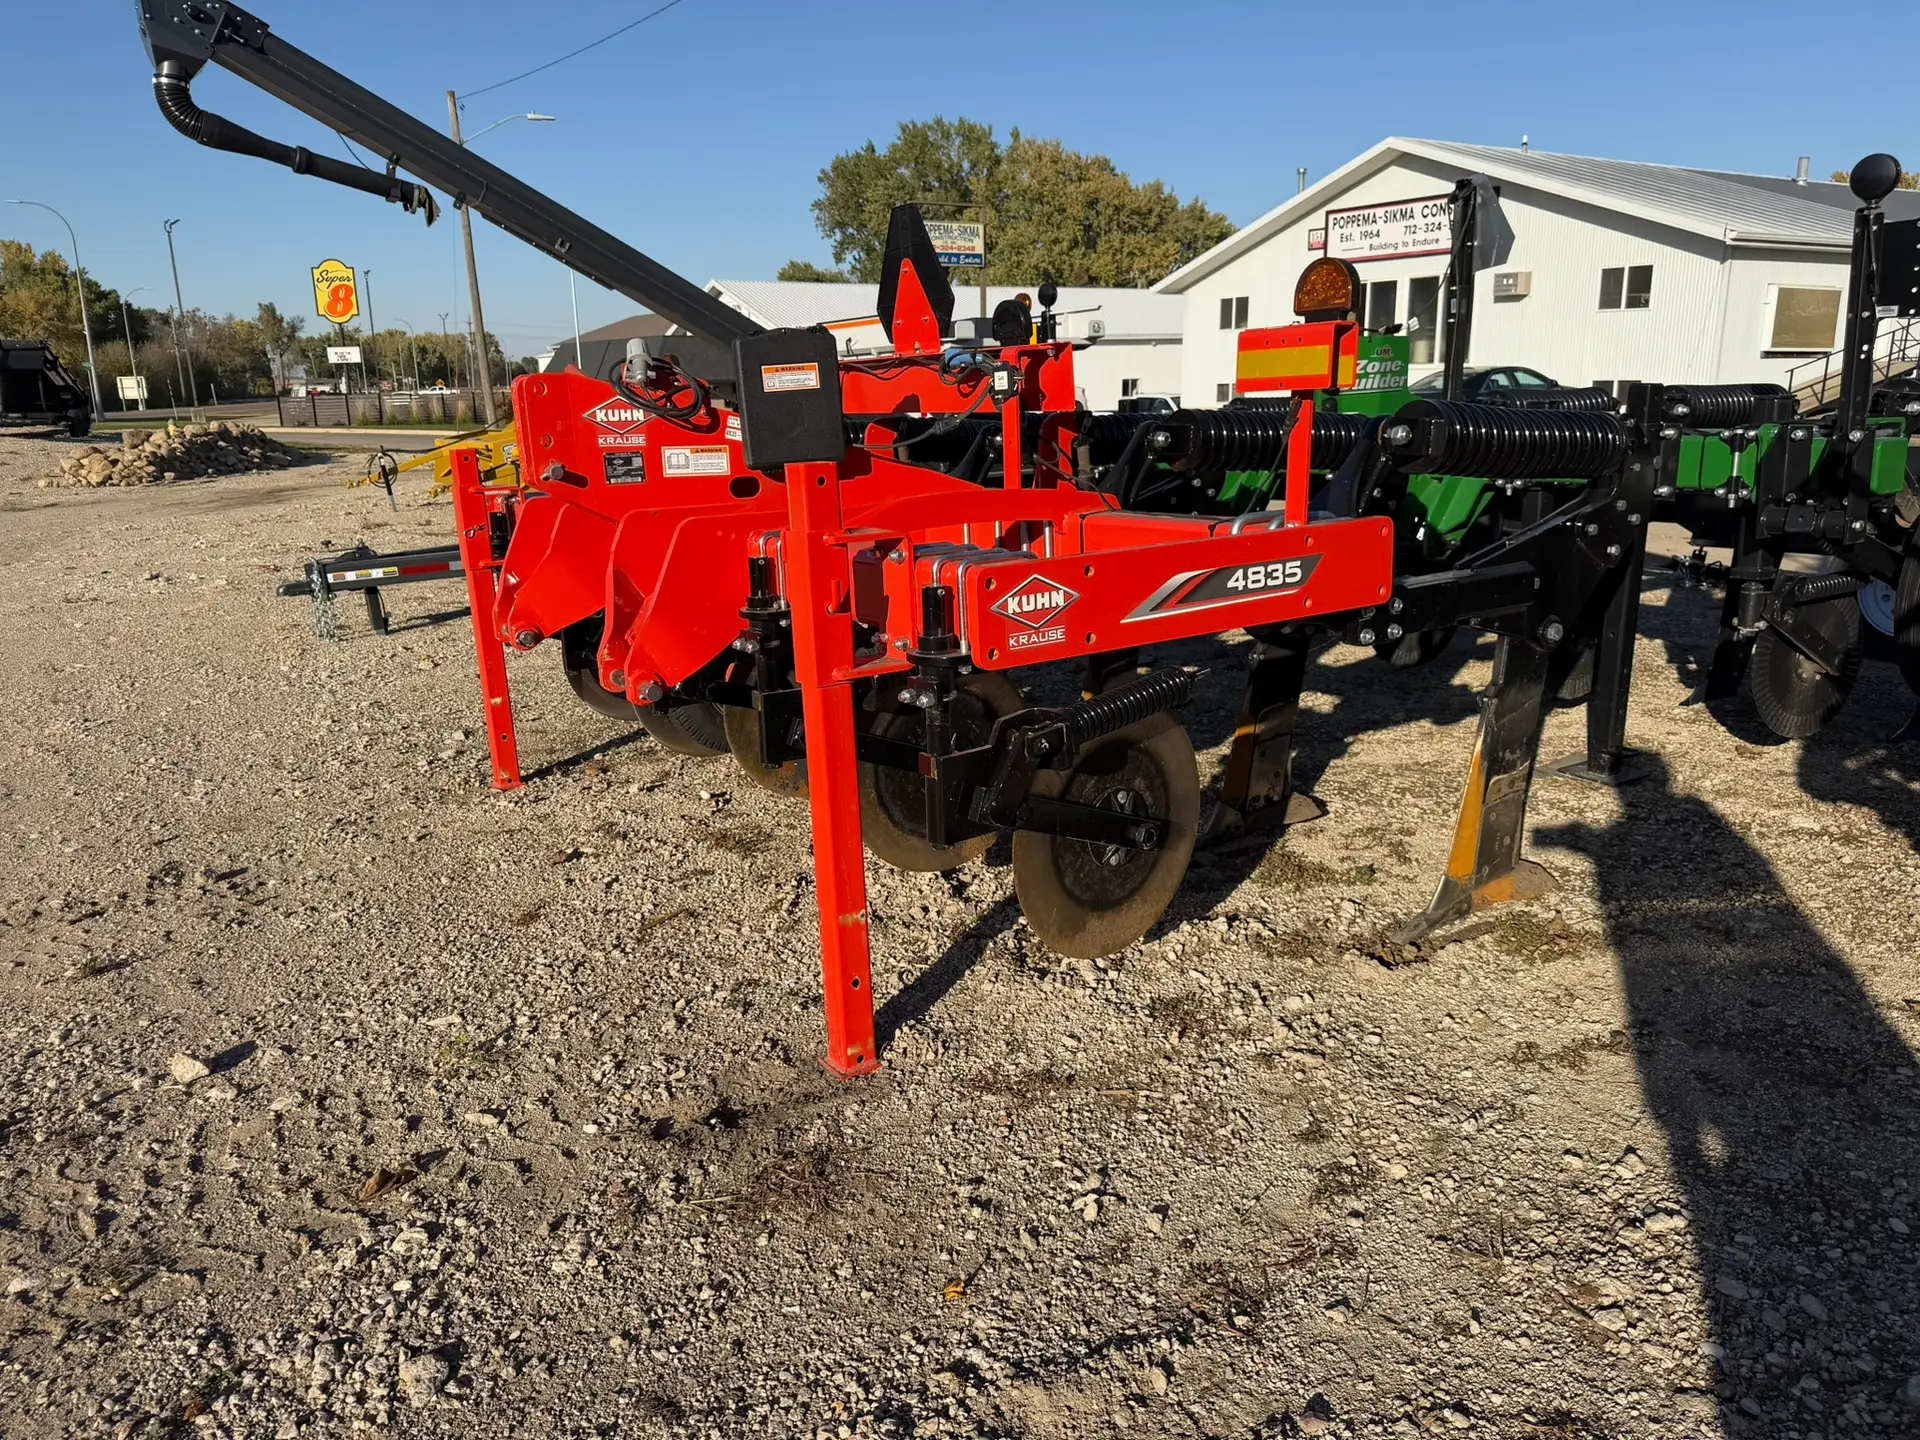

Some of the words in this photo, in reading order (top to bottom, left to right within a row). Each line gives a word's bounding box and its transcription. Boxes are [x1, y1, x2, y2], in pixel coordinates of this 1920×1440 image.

[1333, 206, 1415, 230] POPPEMA-SIKMA
[1340, 232, 1355, 243] Est.
[1359, 229, 1381, 241] 1964
[1369, 242, 1399, 252] Building
[1401, 240, 1409, 248] to
[1412, 237, 1440, 247] Endure
[316, 269, 352, 290] Super
[325, 284, 353, 317] 8
[1356, 360, 1401, 373] Zone
[596, 409, 645, 422] KUHN
[598, 436, 646, 445] KRAUSE
[1226, 560, 1302, 592] 4835
[1007, 589, 1065, 615] KUHN
[1008, 628, 1066, 647] KRAUSE
